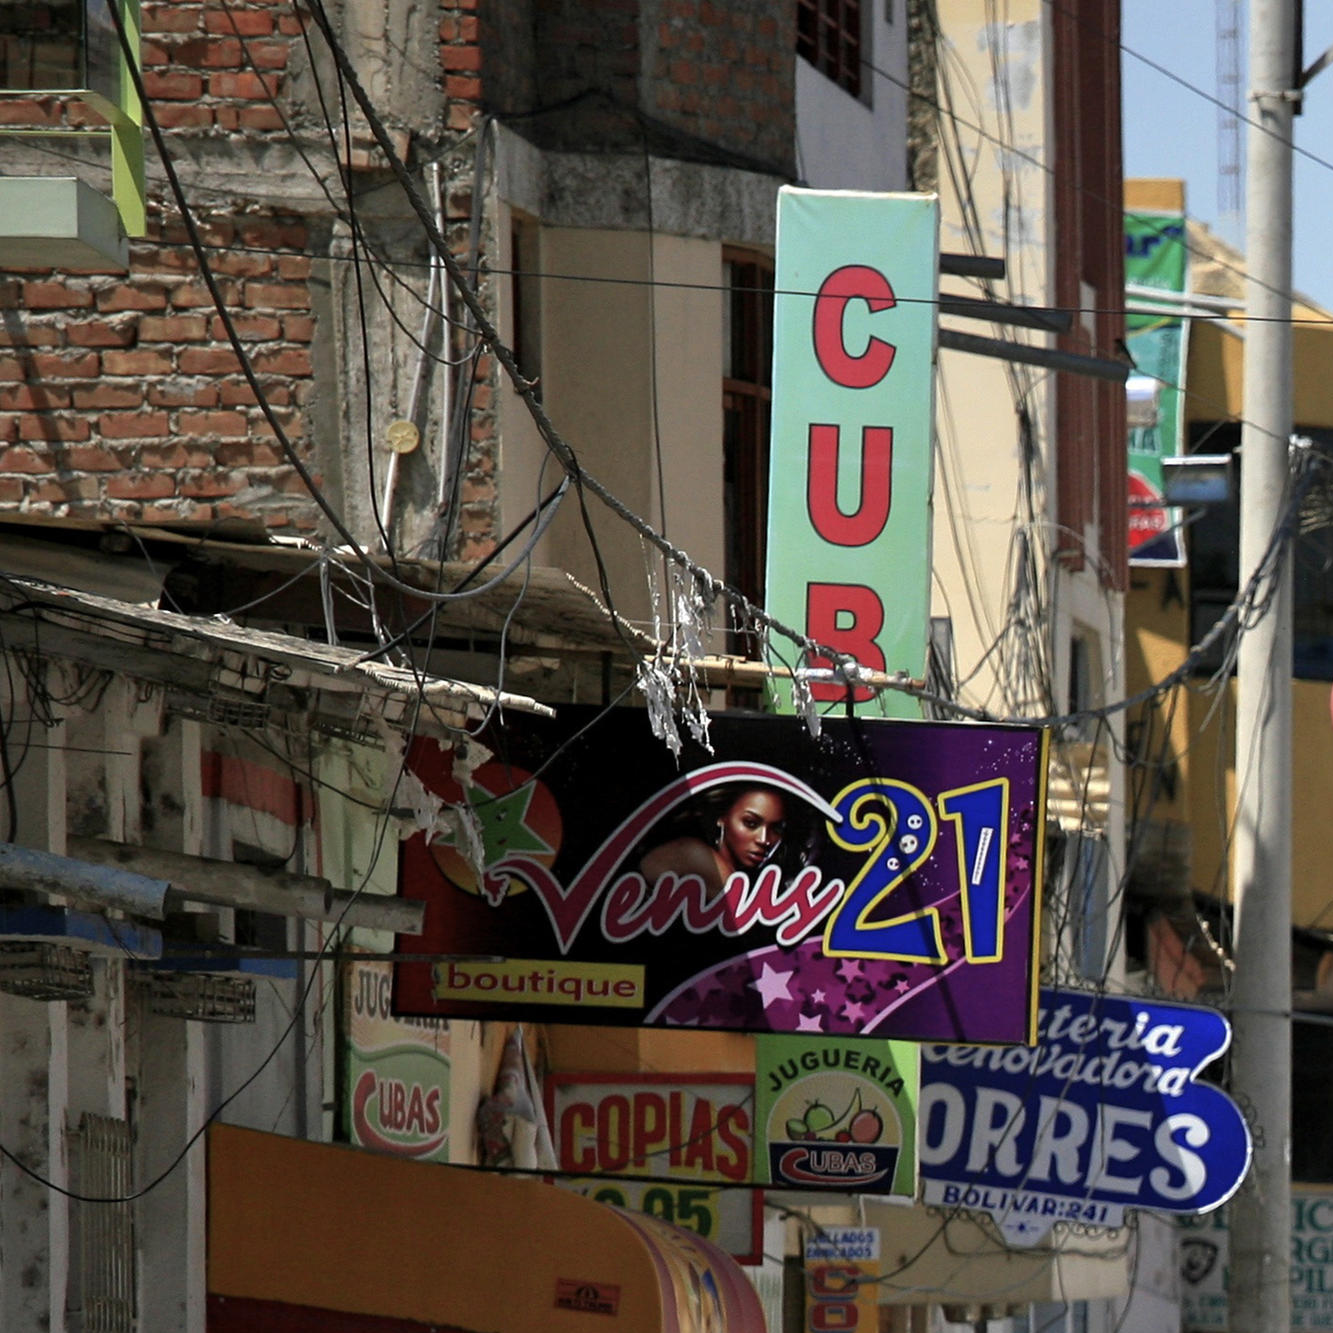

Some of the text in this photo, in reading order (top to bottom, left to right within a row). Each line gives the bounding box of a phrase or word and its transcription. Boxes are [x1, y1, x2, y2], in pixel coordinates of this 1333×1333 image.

[485, 760, 1010, 965] Venus 21
[447, 963, 637, 1002] boutique
[767, 1048, 906, 1098] JUGUERIA
[353, 1070, 450, 1156] CUBAS
[560, 1090, 750, 1181] COPIAS
[779, 1147, 890, 1185] CUBAS
